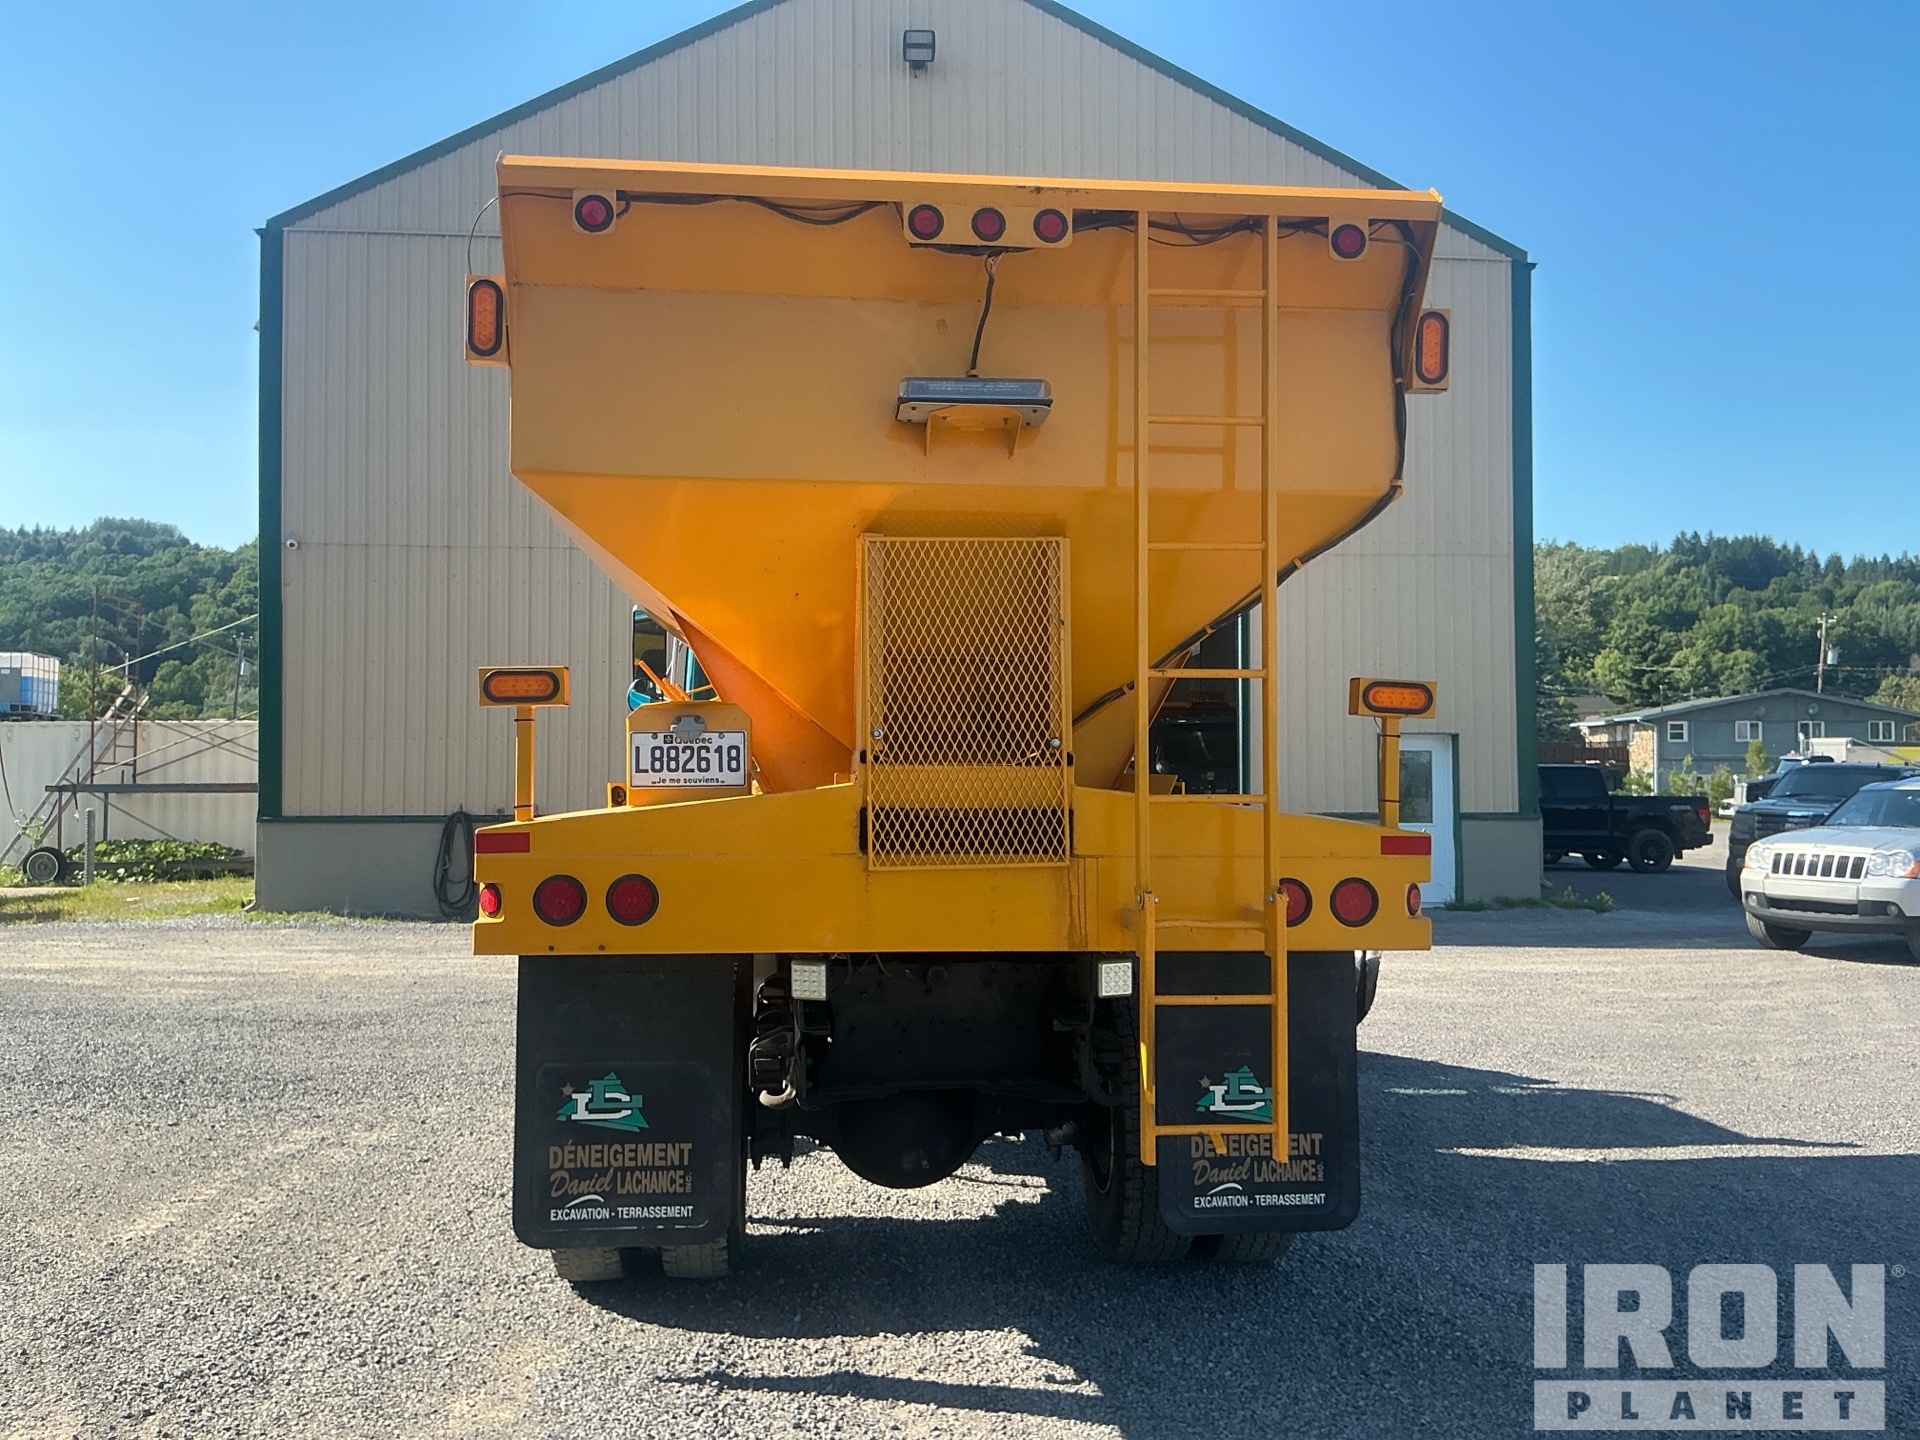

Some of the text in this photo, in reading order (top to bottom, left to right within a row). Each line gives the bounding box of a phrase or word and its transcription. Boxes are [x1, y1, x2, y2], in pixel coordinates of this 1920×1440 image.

[634, 745, 741, 773] L882618
[683, 776, 720, 784] souviens
[549, 1139, 693, 1169] DÉNEIGEMENT
[550, 1167, 615, 1198] Daniel
[616, 1170, 684, 1195] LACHANCE
[1192, 1156, 1252, 1186] Daniel
[1253, 1159, 1317, 1183] LACHANCE
[550, 1207, 610, 1221] EXCAVATION
[617, 1205, 694, 1219] TERRASSEMENT
[1194, 1194, 1249, 1209] EXCAVATION
[1255, 1193, 1326, 1207] TERRASSEMENT
